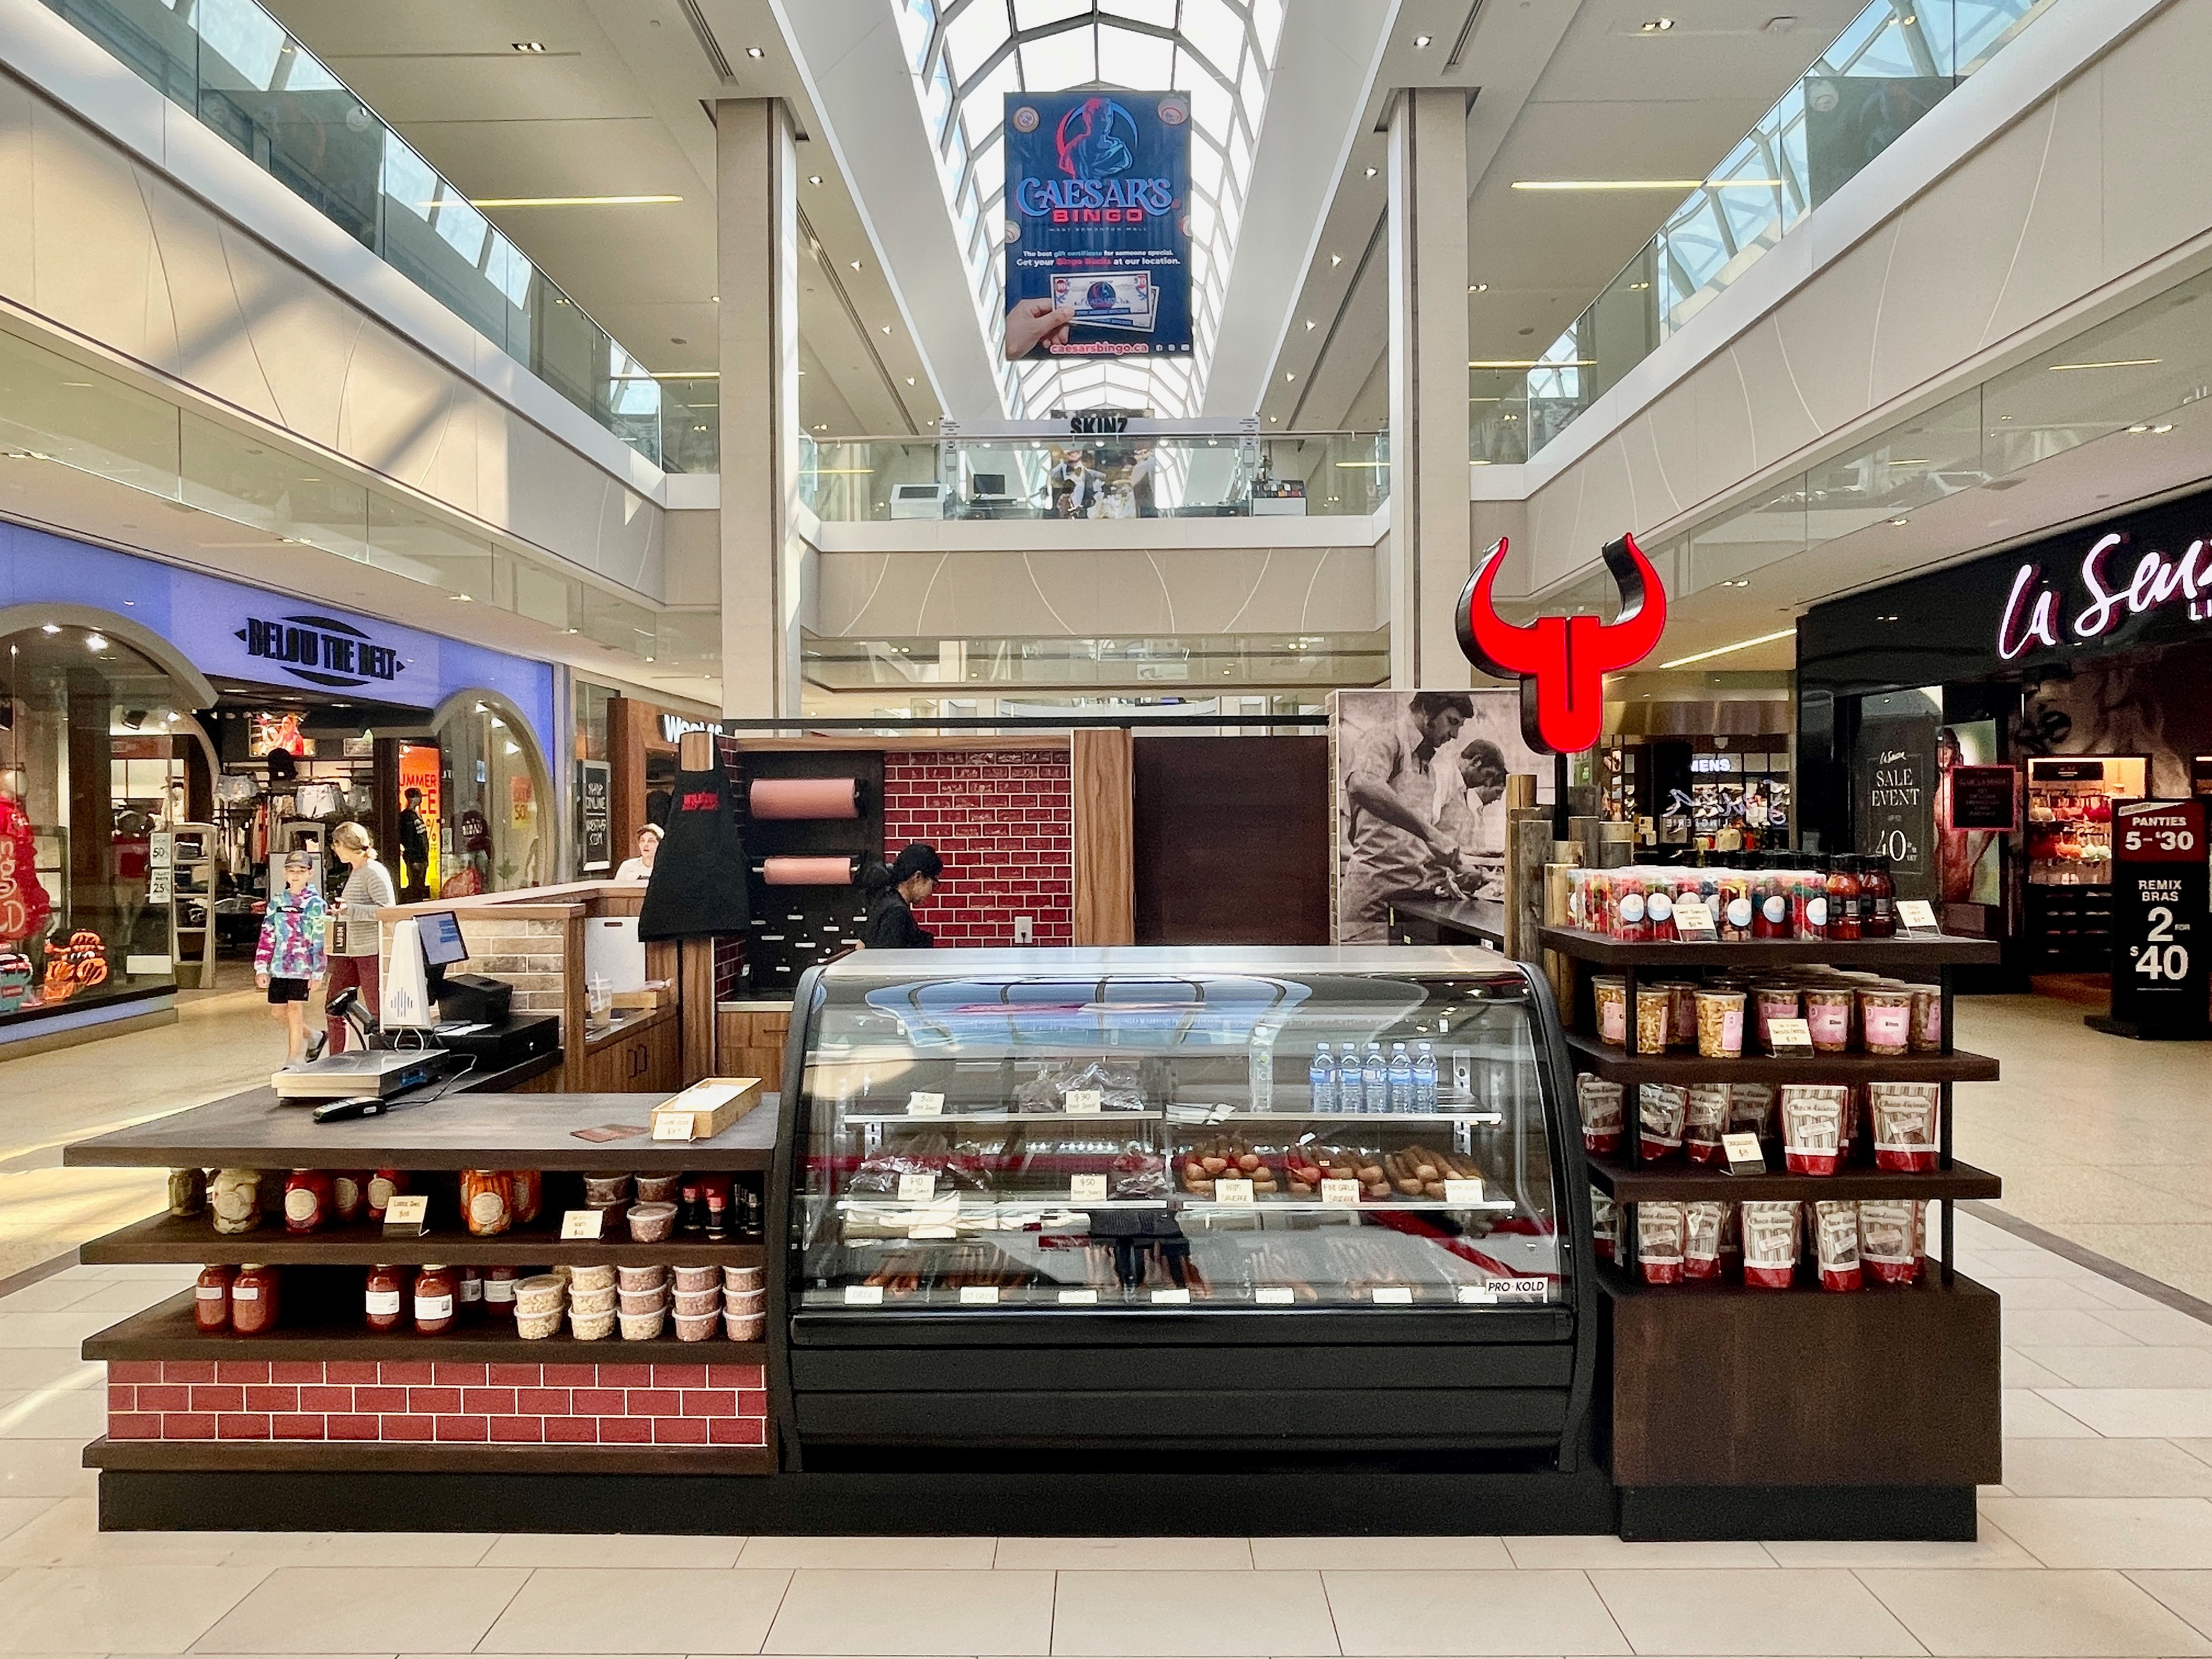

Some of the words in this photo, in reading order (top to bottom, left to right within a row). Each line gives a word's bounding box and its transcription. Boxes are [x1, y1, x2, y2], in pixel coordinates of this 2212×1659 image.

[1016, 177, 1172, 216] CAESAR'S
[1052, 209, 1143, 223] BINGO
[1142, 257, 1180, 266] location.
[1050, 342, 1149, 355] caesarsbingo.ca
[247, 617, 318, 666] BELOW
[321, 634, 355, 673] THE
[357, 642, 396, 680] BELT
[1876, 768, 1913, 787] SALE
[1872, 788, 1920, 806] EVENT
[2132, 817, 2187, 826] PANTIES
[2138, 880, 2182, 890] REMIX
[2142, 891, 2179, 901] BRAS
[2147, 906, 2173, 941] 2
[2130, 945, 2189, 980] $40
